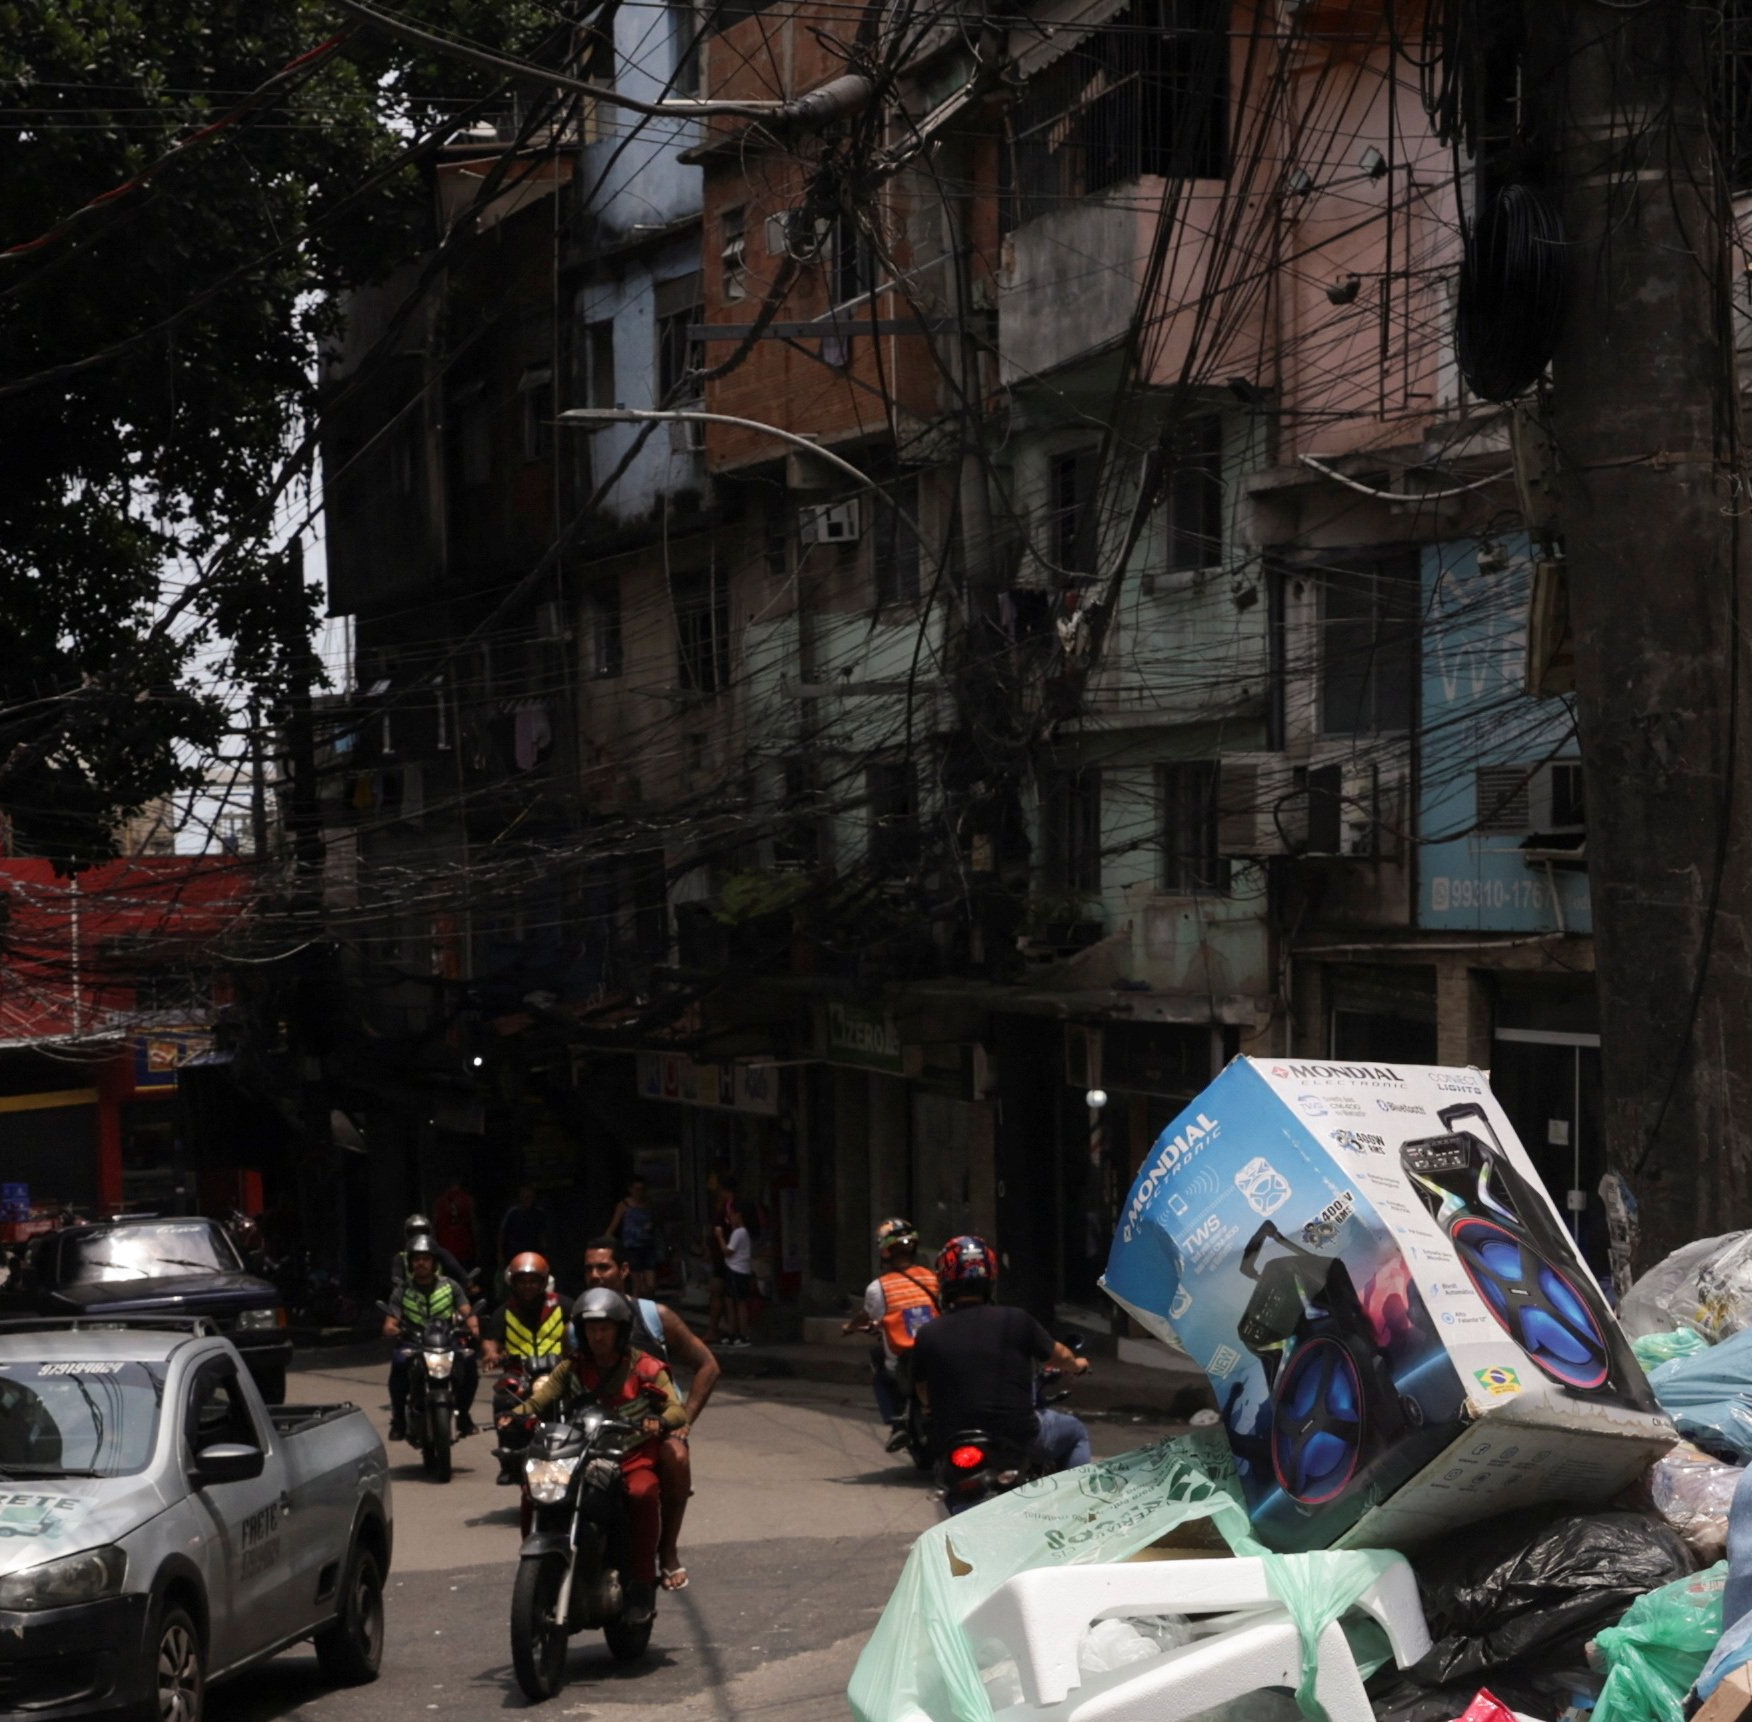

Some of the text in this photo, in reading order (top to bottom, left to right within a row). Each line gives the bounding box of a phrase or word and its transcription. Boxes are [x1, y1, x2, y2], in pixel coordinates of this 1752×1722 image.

[1288, 1064, 1405, 1083] MONDIAL
[1301, 1080, 1409, 1090] ELECTRONIC
[1128, 1113, 1219, 1227] MONDIAL
[1182, 1214, 1222, 1254] TWS
[1211, 1346, 1236, 1377] NEW
[241, 1503, 279, 1550] FRETE
